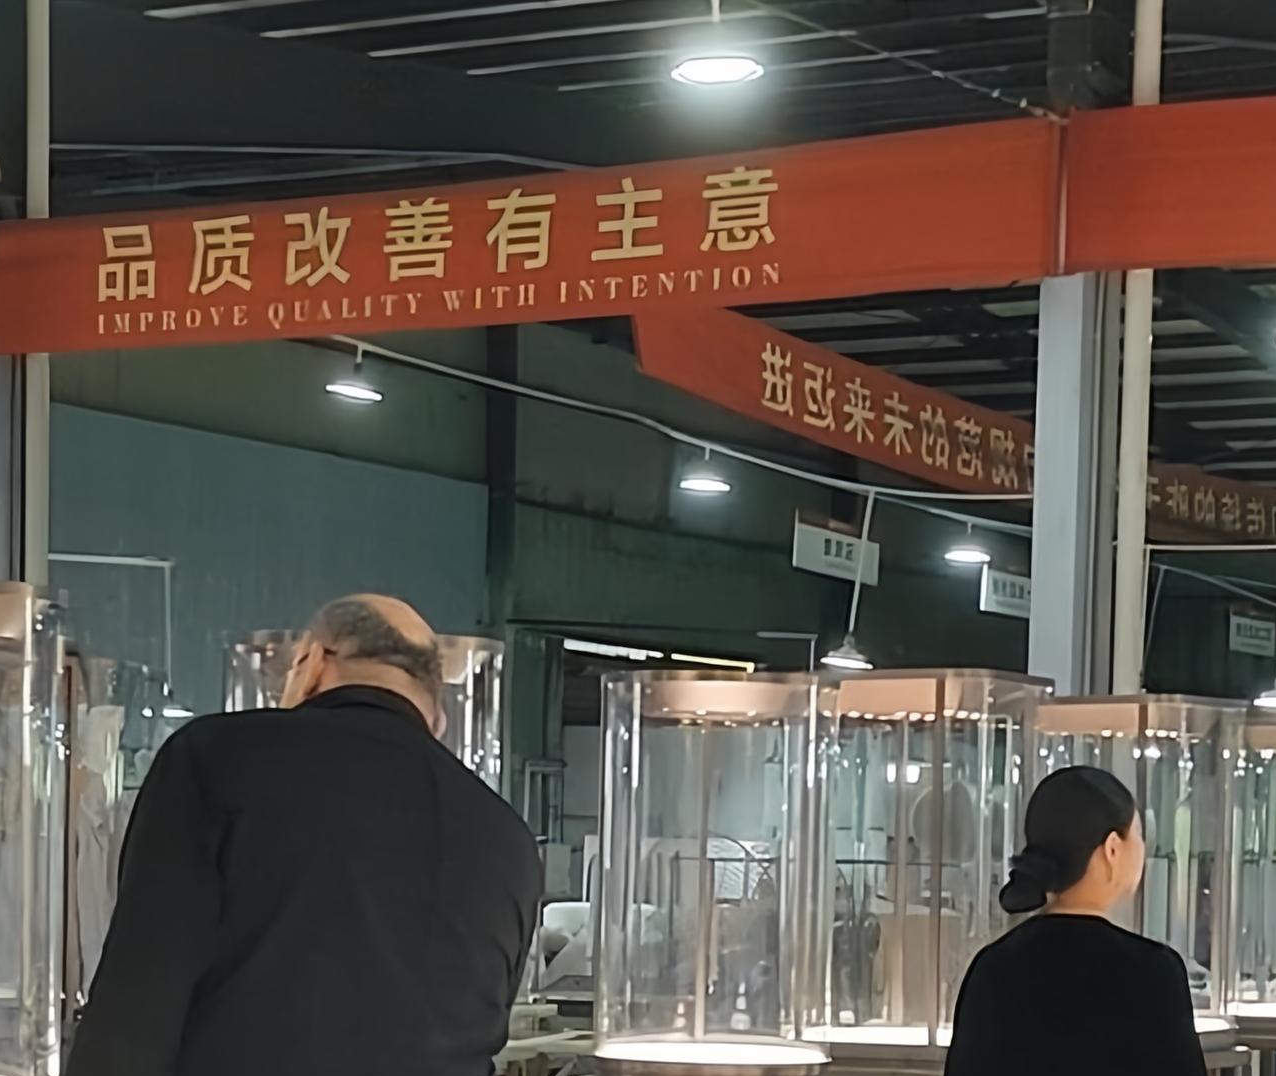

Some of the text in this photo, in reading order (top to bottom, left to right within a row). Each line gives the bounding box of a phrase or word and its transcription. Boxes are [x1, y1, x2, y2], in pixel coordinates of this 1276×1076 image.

[98, 165, 779, 302] 品质改善有主意
[98, 262, 782, 334] IMPROVE QUALITY WITH INTENTION
